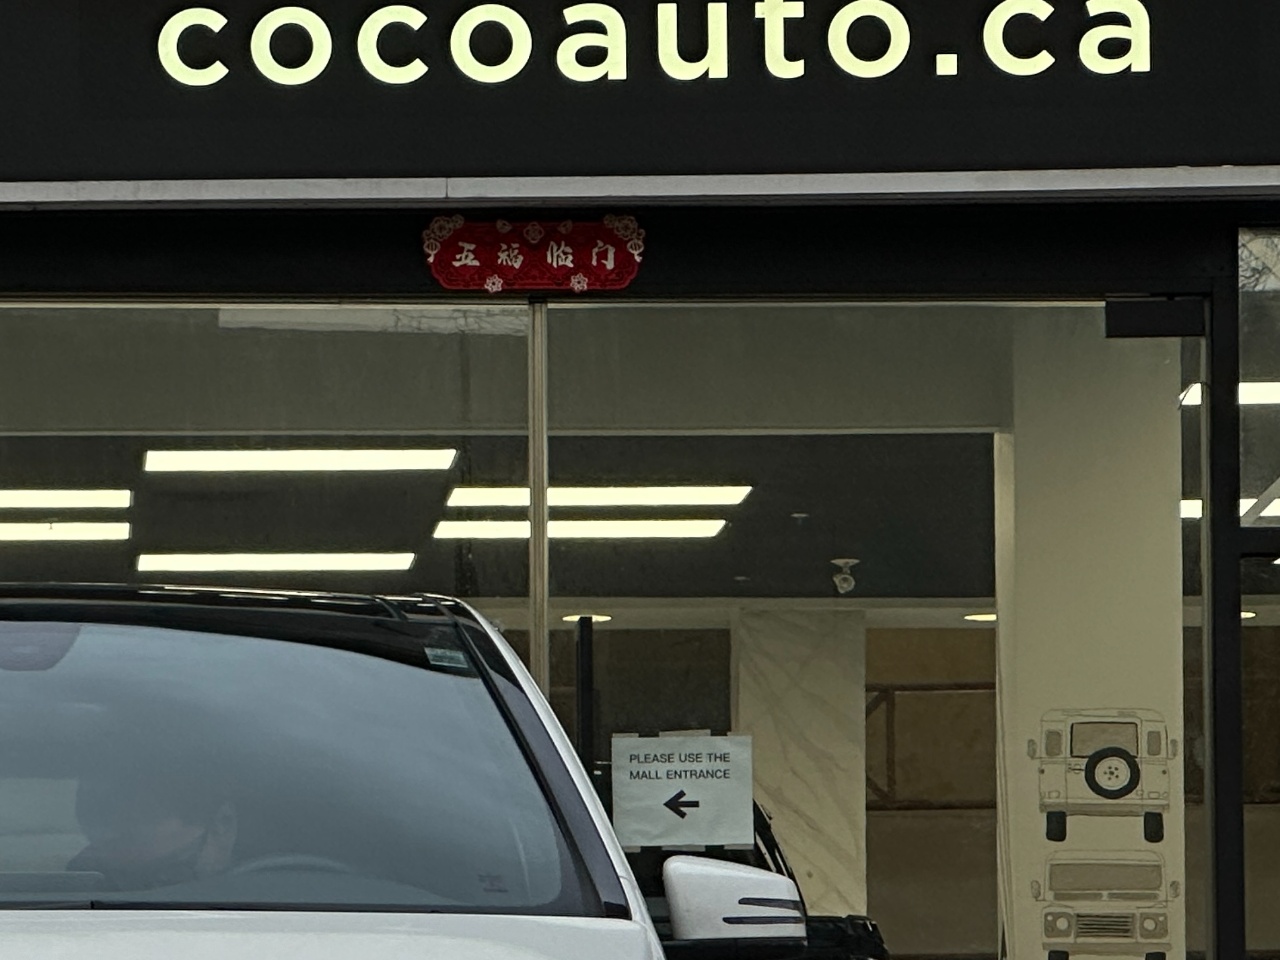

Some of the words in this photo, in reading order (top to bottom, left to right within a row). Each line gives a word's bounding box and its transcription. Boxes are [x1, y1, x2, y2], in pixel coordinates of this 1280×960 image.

[157, 0, 1152, 87] cocoauto.ca
[451, 240, 617, 271] 五福临门
[628, 753, 675, 764] PLEASE
[678, 752, 703, 763] USE
[706, 752, 731, 763] THE
[628, 769, 663, 780] MALL
[666, 768, 731, 780] ENTRANCE
